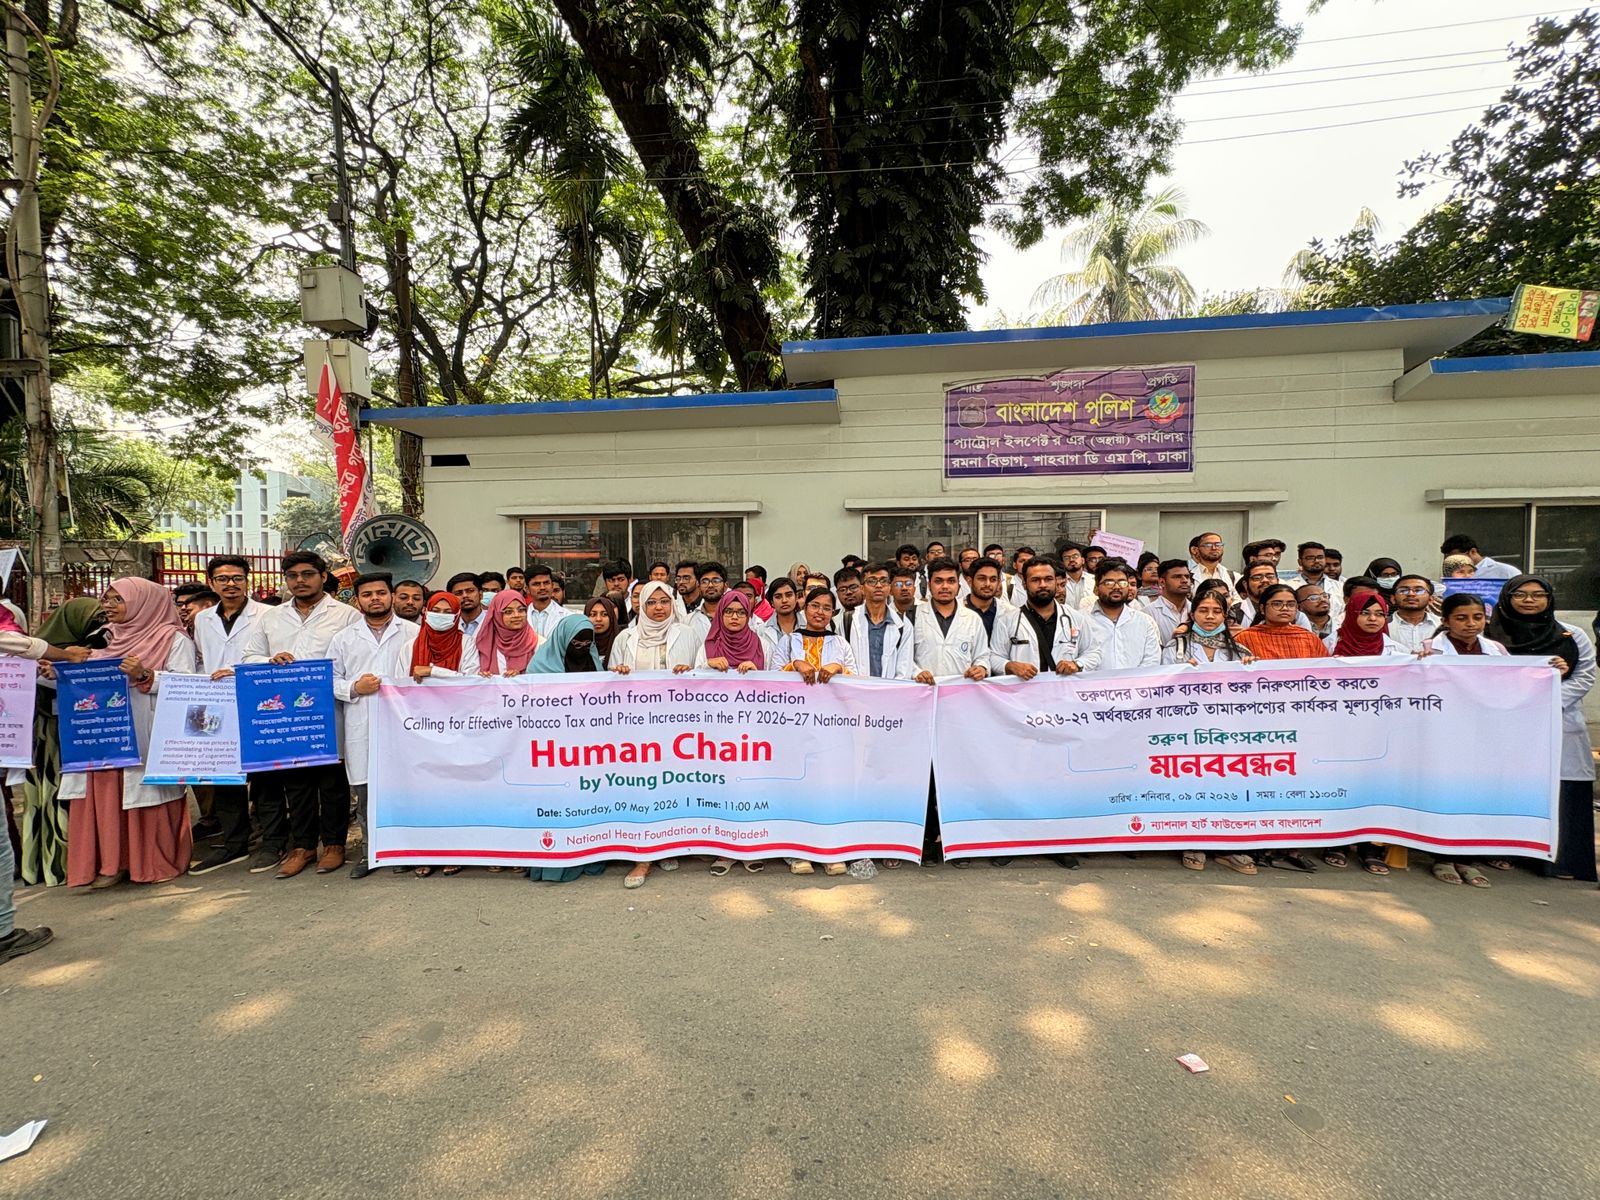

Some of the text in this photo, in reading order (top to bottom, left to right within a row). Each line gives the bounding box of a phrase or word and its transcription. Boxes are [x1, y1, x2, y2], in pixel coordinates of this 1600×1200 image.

[994, 392, 1136, 427] বাংলাদেশ পুলিশ
[1066, 435, 1087, 446] এর
[1134, 429, 1185, 444] কার্যালয়
[950, 449, 1187, 469] রমনা বিভাগ, শাহবাগ ডি এম পি, ঢাকা
[502, 689, 806, 708] To Protect Youth from Tobacco Addiction
[1076, 675, 1380, 703] তরুণদের তামাক ব্যবহার শুরু নিরুৎসাহিত করতে
[403, 716, 445, 734] Calling
[448, 716, 465, 730] for
[468, 716, 513, 731] Effective
[516, 715, 562, 730] Tobacco
[564, 714, 586, 728] Tax
[589, 713, 613, 727] and
[617, 711, 645, 726] Price
[648, 711, 701, 725] Increases
[703, 710, 714, 724] in
[716, 710, 734, 724] the
[737, 710, 752, 724] FY
[813, 712, 861, 728] National
[864, 714, 904, 732] Budget
[1025, 694, 1443, 729] ২০২৬-২৭ অর্থবছরের বাজেটে তামাকপণ্যের কার্যকর মূল্যবৃদ্ধির দাবি
[1148, 728, 1298, 747] তরুণ চিকিৎসকদের
[530, 732, 772, 768] Human Chain
[1148, 751, 1297, 779] মানববন্ধন
[579, 769, 726, 793] by Young Doctors
[1108, 793, 1133, 805] তারিখ
[1178, 794, 1192, 802] ০৯
[1195, 790, 1208, 801] মে
[1209, 791, 1238, 802] ২০২৬
[1256, 790, 1277, 801] সময়
[1285, 789, 1306, 800] বেলা
[1309, 787, 1348, 799] ১১:০০টা
[537, 798, 769, 818] Date: Saturday, 09 May 2026 Time: 11:00 AM
[1150, 816, 1322, 831] ন্যাশনাল হার্ট ফাউন্ডেশন অব বাংলাদেশ
[566, 825, 769, 846] National Heart Foundation of Bangladesh
